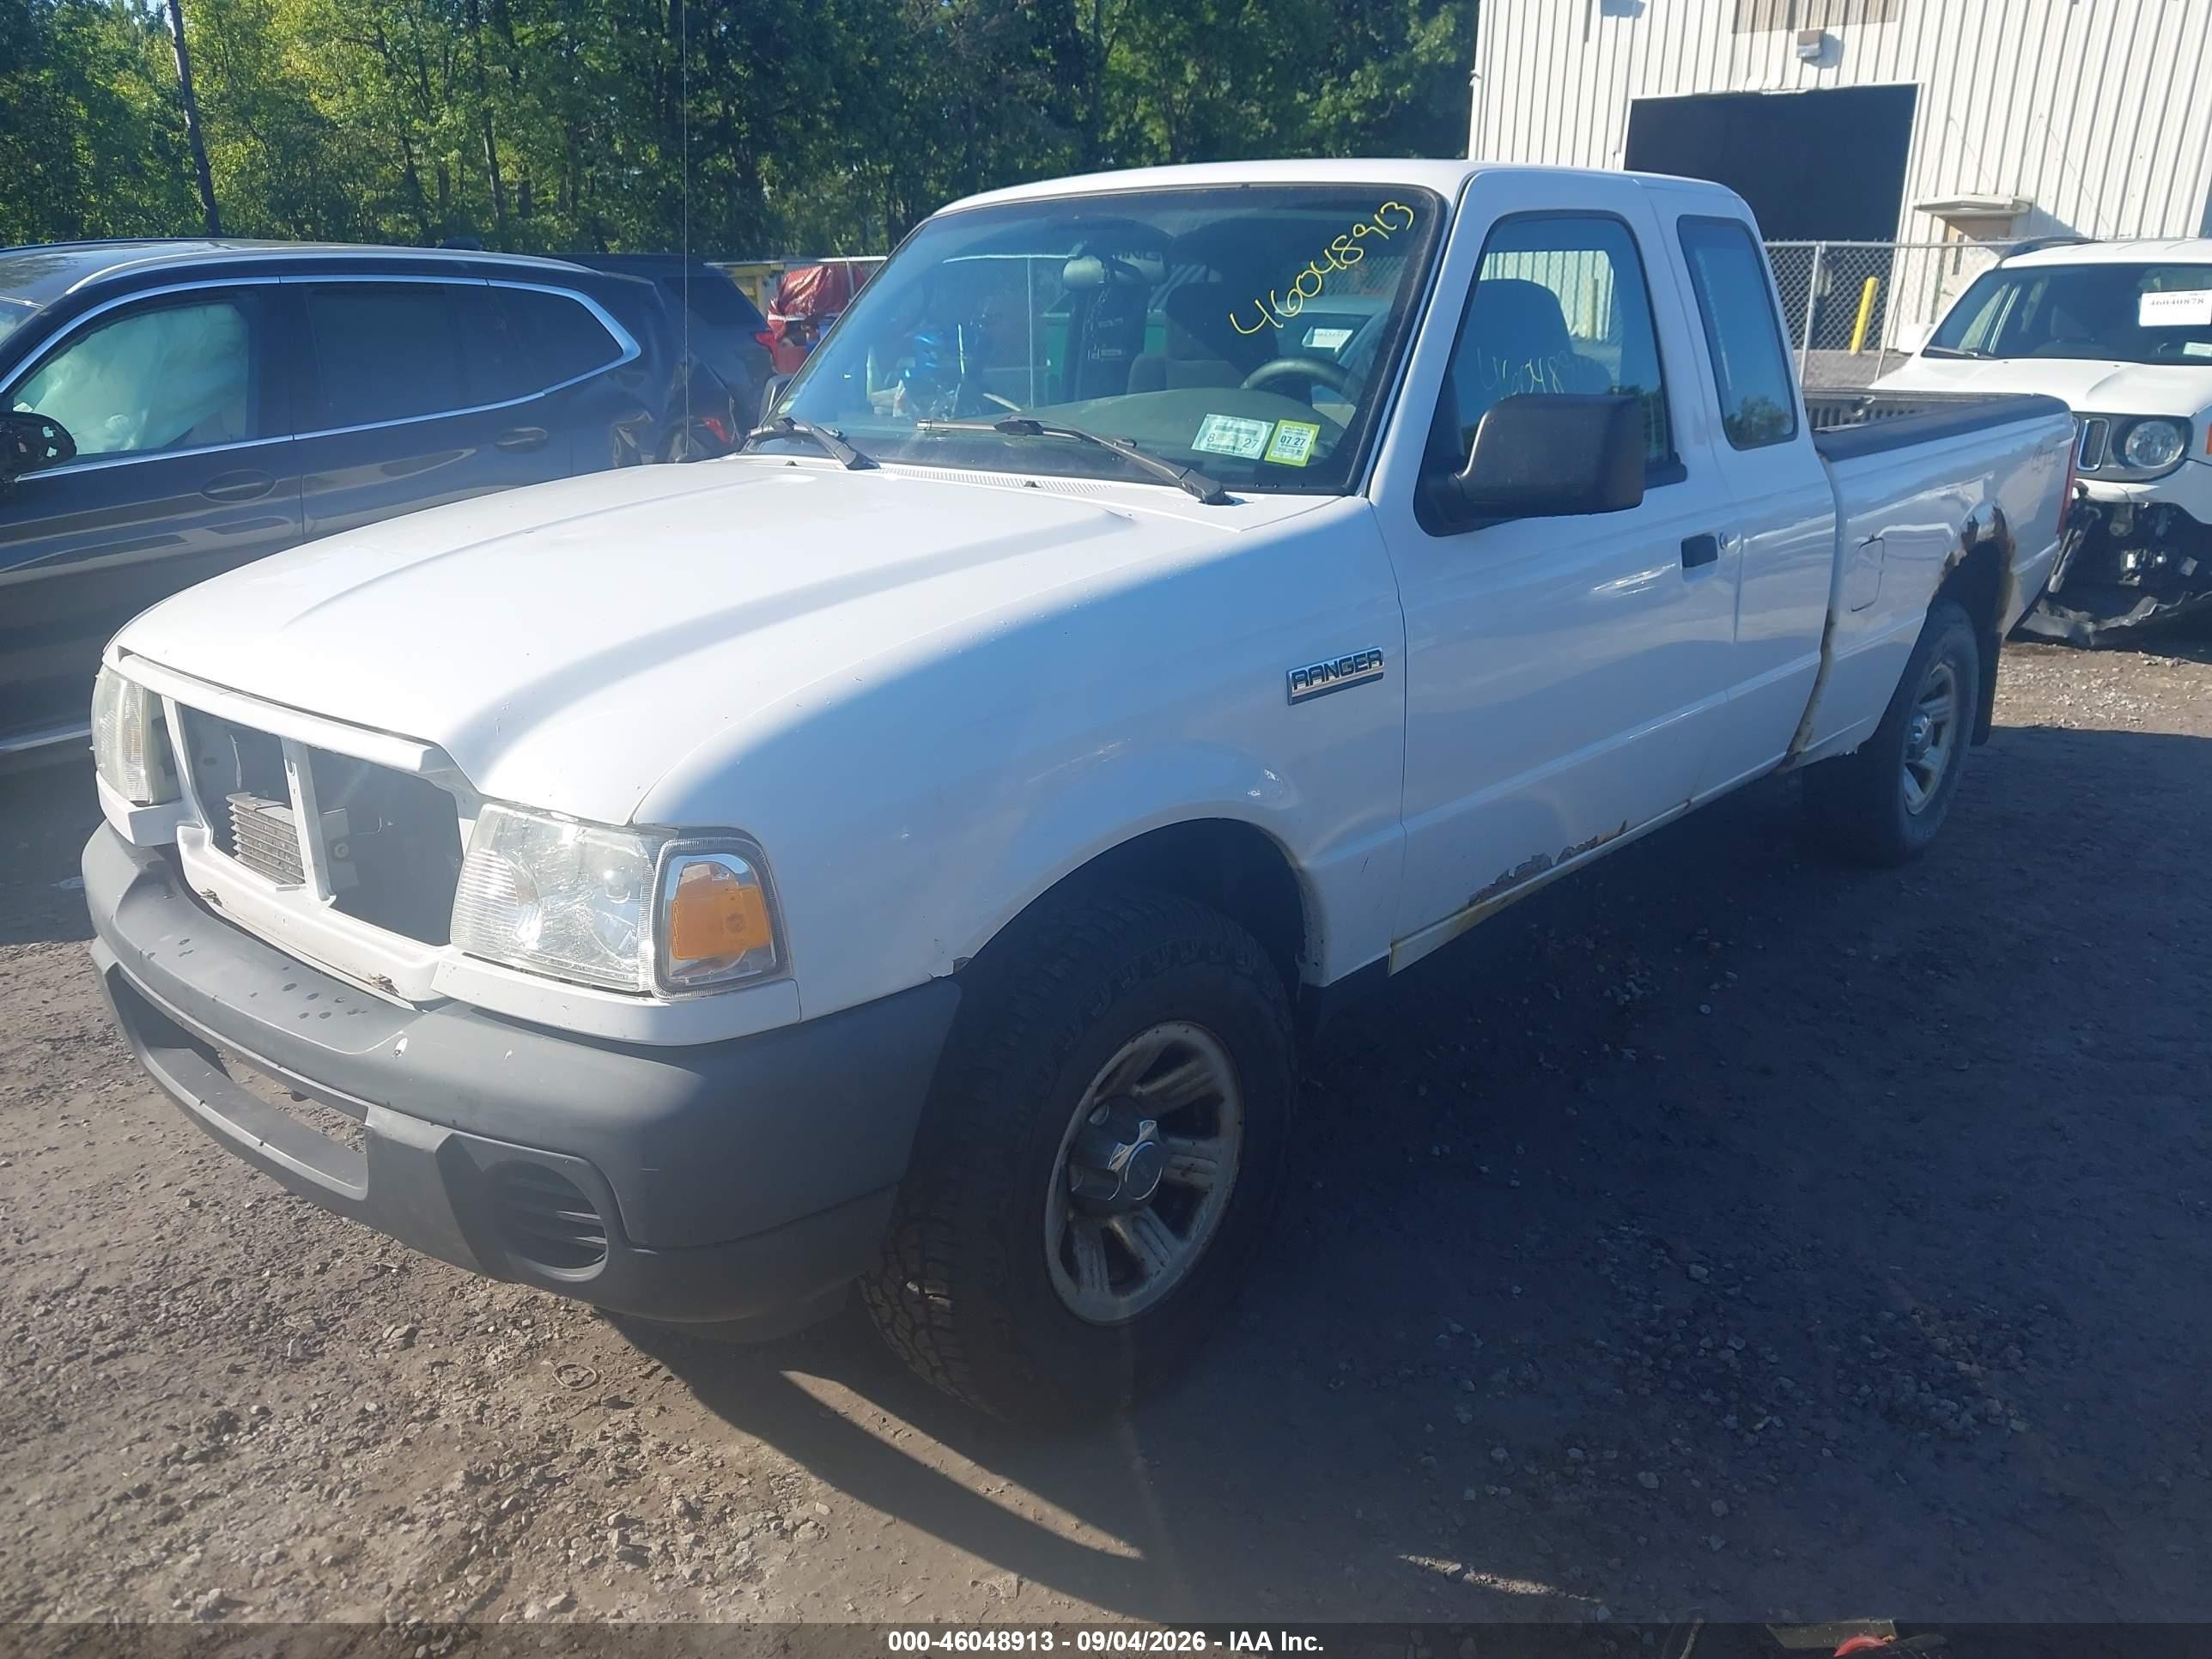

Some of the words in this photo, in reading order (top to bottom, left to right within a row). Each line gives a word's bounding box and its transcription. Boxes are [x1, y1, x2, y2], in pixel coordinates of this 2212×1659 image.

[1229, 201, 1415, 335] 46048913
[1206, 432, 1216, 442] 8
[1243, 437, 1260, 449] 27
[1279, 434, 1292, 445] 07
[1293, 437, 1306, 447] 27
[1291, 649, 1383, 690] RANGER
